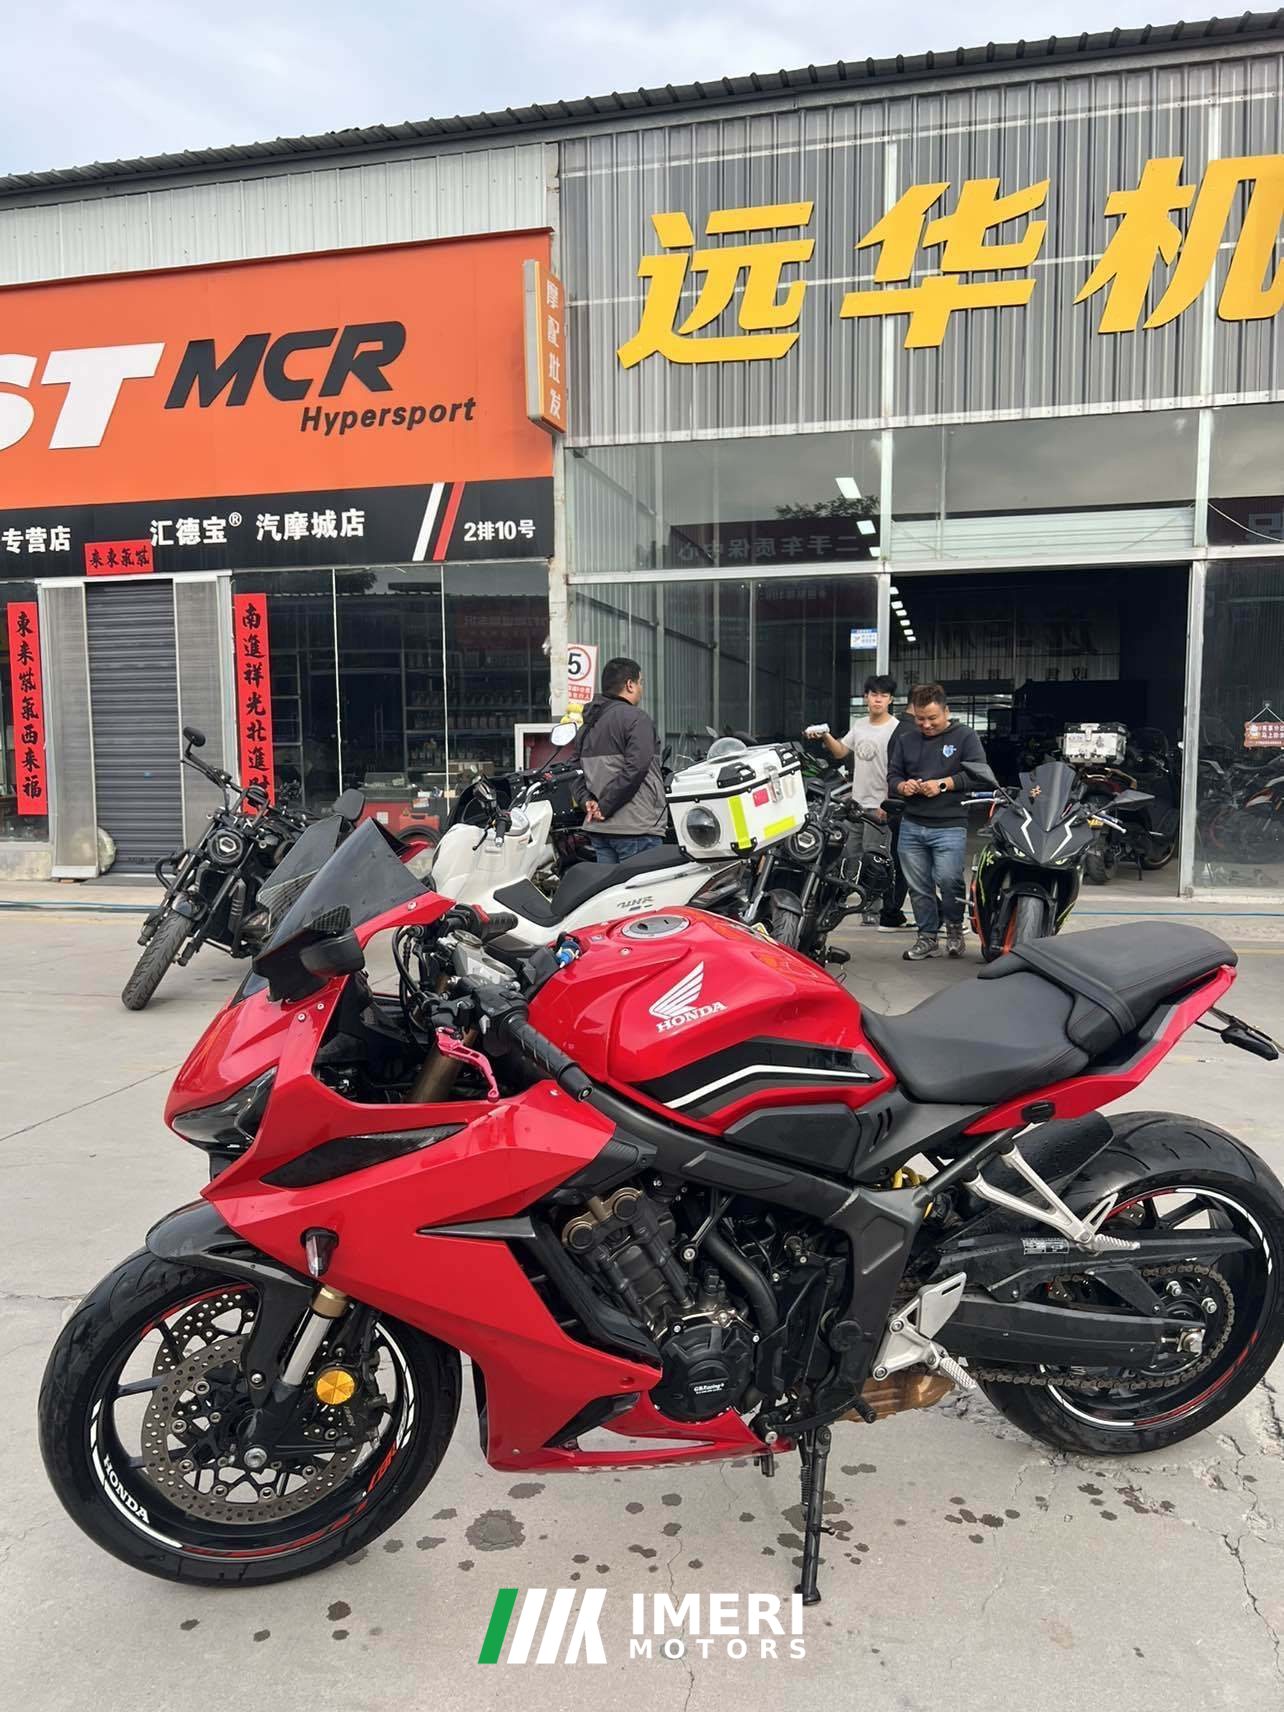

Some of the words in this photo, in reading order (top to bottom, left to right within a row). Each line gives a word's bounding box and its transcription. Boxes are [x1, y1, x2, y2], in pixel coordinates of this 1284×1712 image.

[618, 156, 1284, 369] 远华机
[165, 321, 407, 410] MCR
[300, 396, 477, 435] Hypersport
[1, 525, 71, 554] 专营店
[255, 508, 365, 542] 汽摩城店
[463, 520, 536, 542] 2排10号
[568, 653, 581, 675] 5
[656, 1002, 728, 1032] HONDA
[103, 1453, 150, 1524] HONDA
